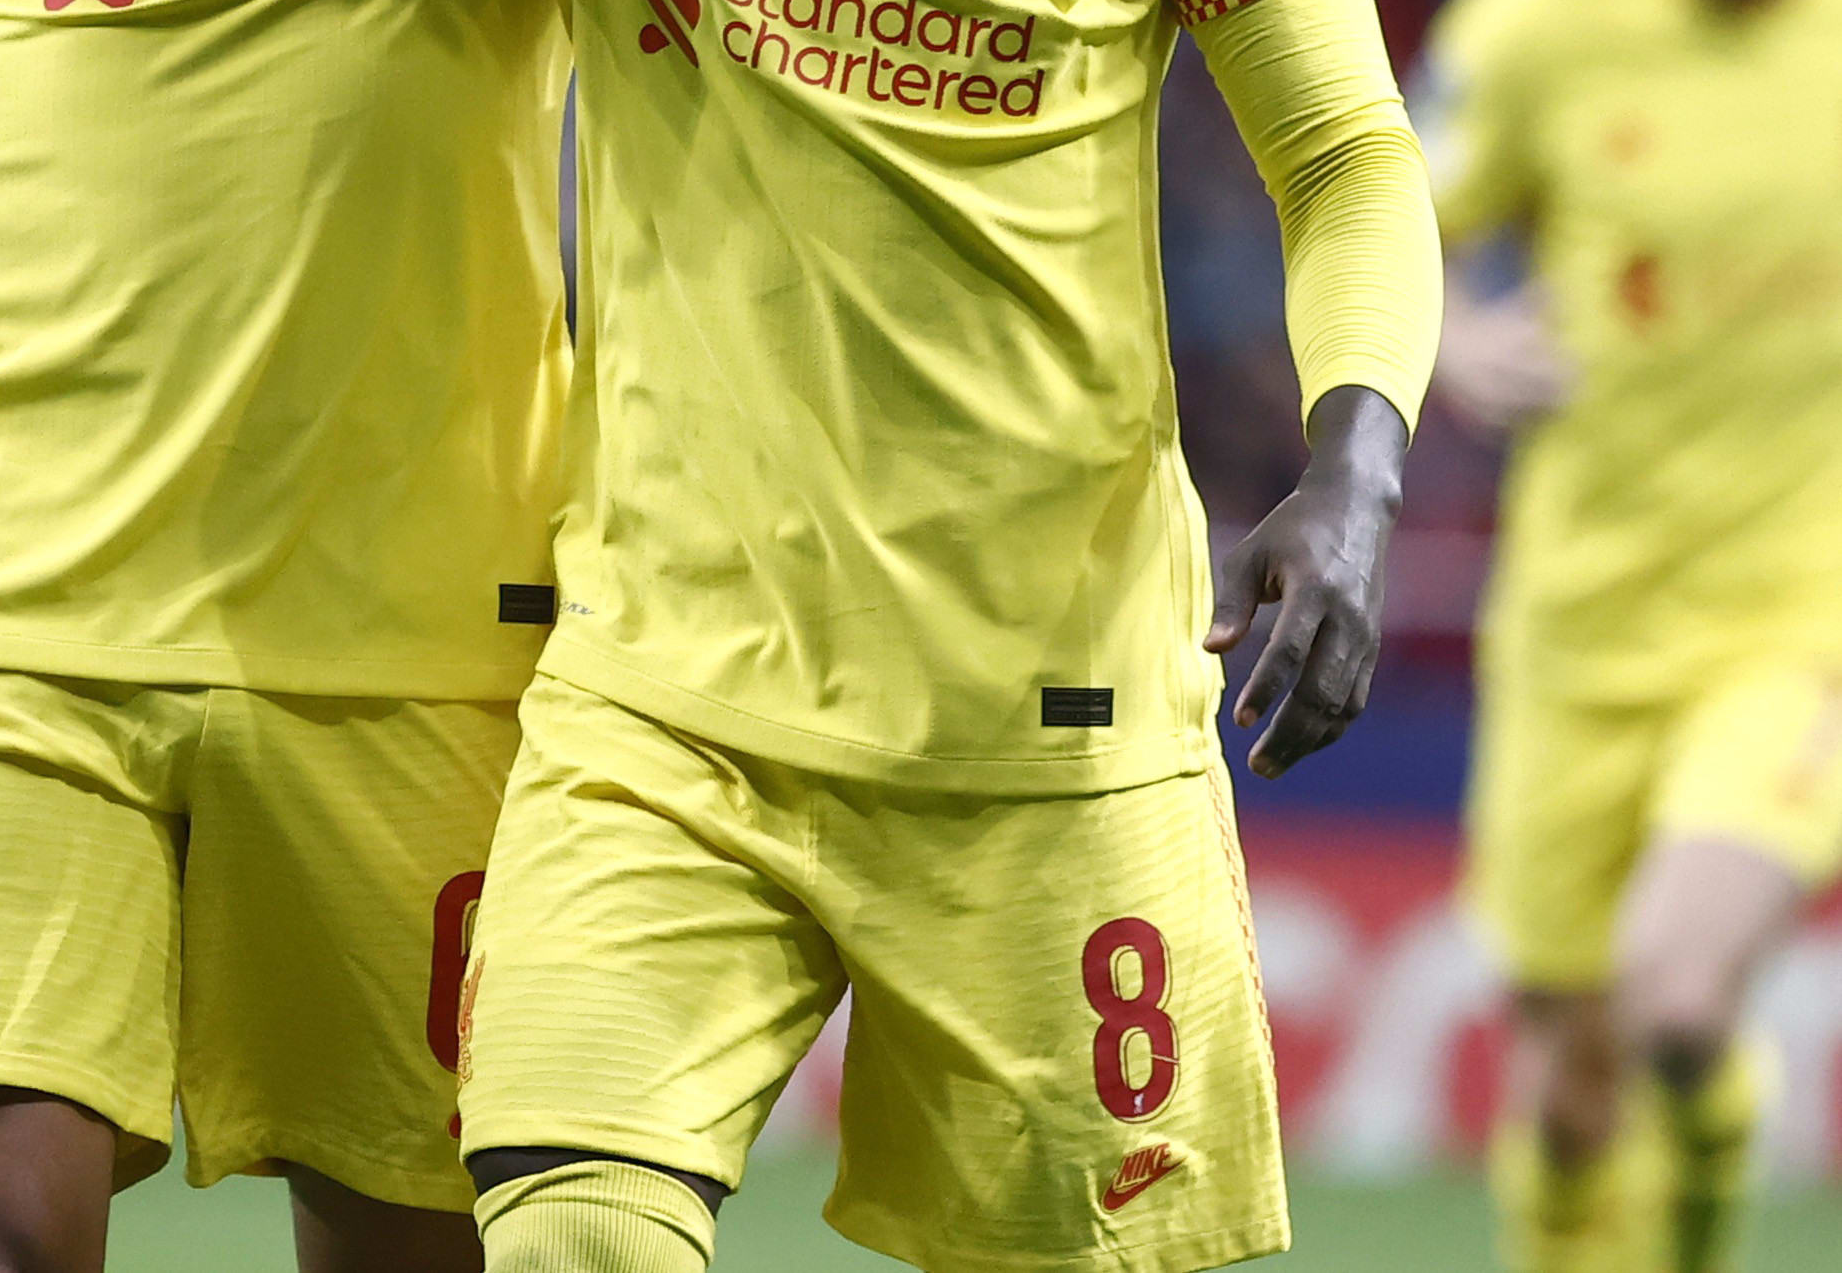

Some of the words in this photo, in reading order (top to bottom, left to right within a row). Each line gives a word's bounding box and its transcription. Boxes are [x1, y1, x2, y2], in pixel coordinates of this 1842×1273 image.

[721, 18, 1045, 117] chartered
[1081, 916, 1180, 1124] 8
[1116, 1142, 1173, 1187] NIKE
